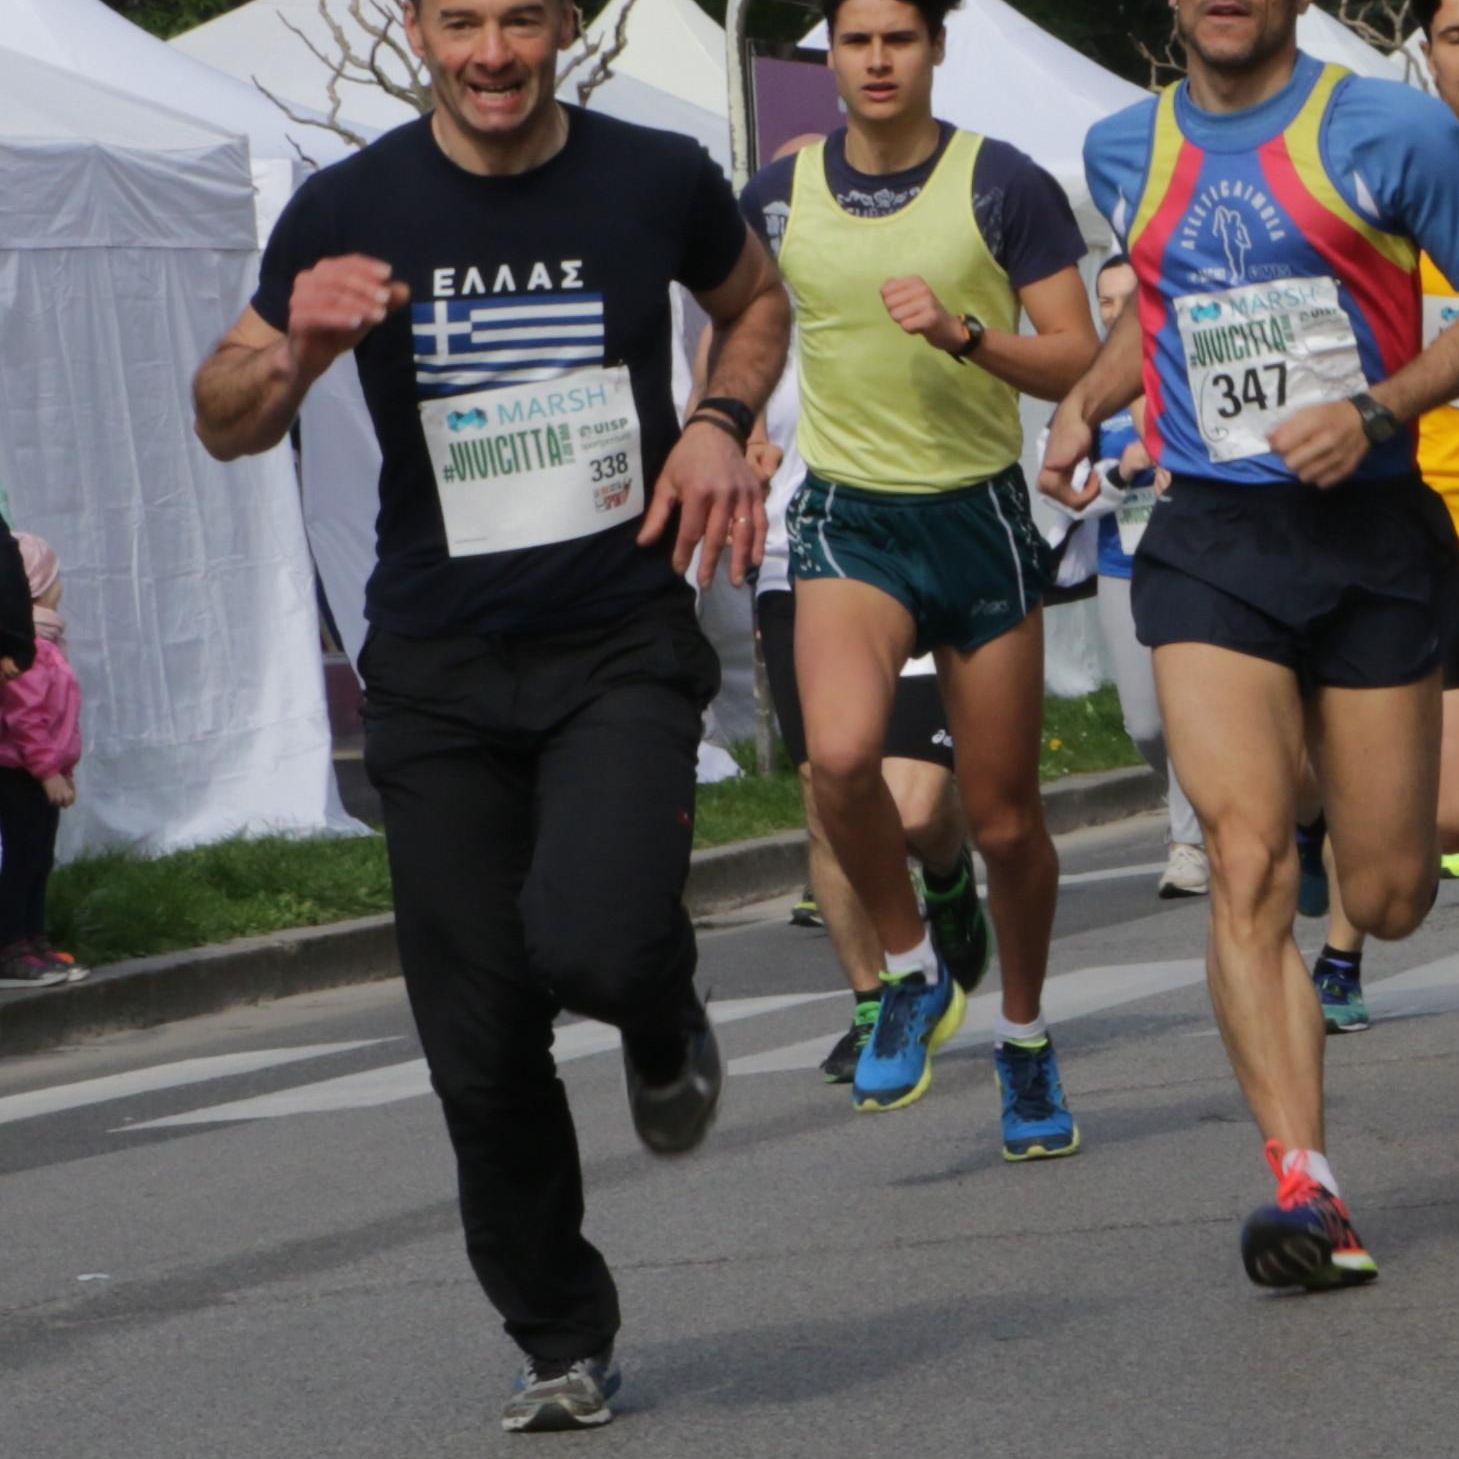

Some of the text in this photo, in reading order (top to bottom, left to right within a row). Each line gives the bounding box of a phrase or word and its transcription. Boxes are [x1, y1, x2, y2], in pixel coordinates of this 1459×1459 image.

[432, 259, 584, 297] ΕΛΛΑΣ
[1229, 285, 1319, 317] MARSH
[496, 384, 608, 426] MARSH
[1211, 360, 1288, 419] 347
[593, 417, 629, 435] UISP
[589, 451, 629, 482] 338
